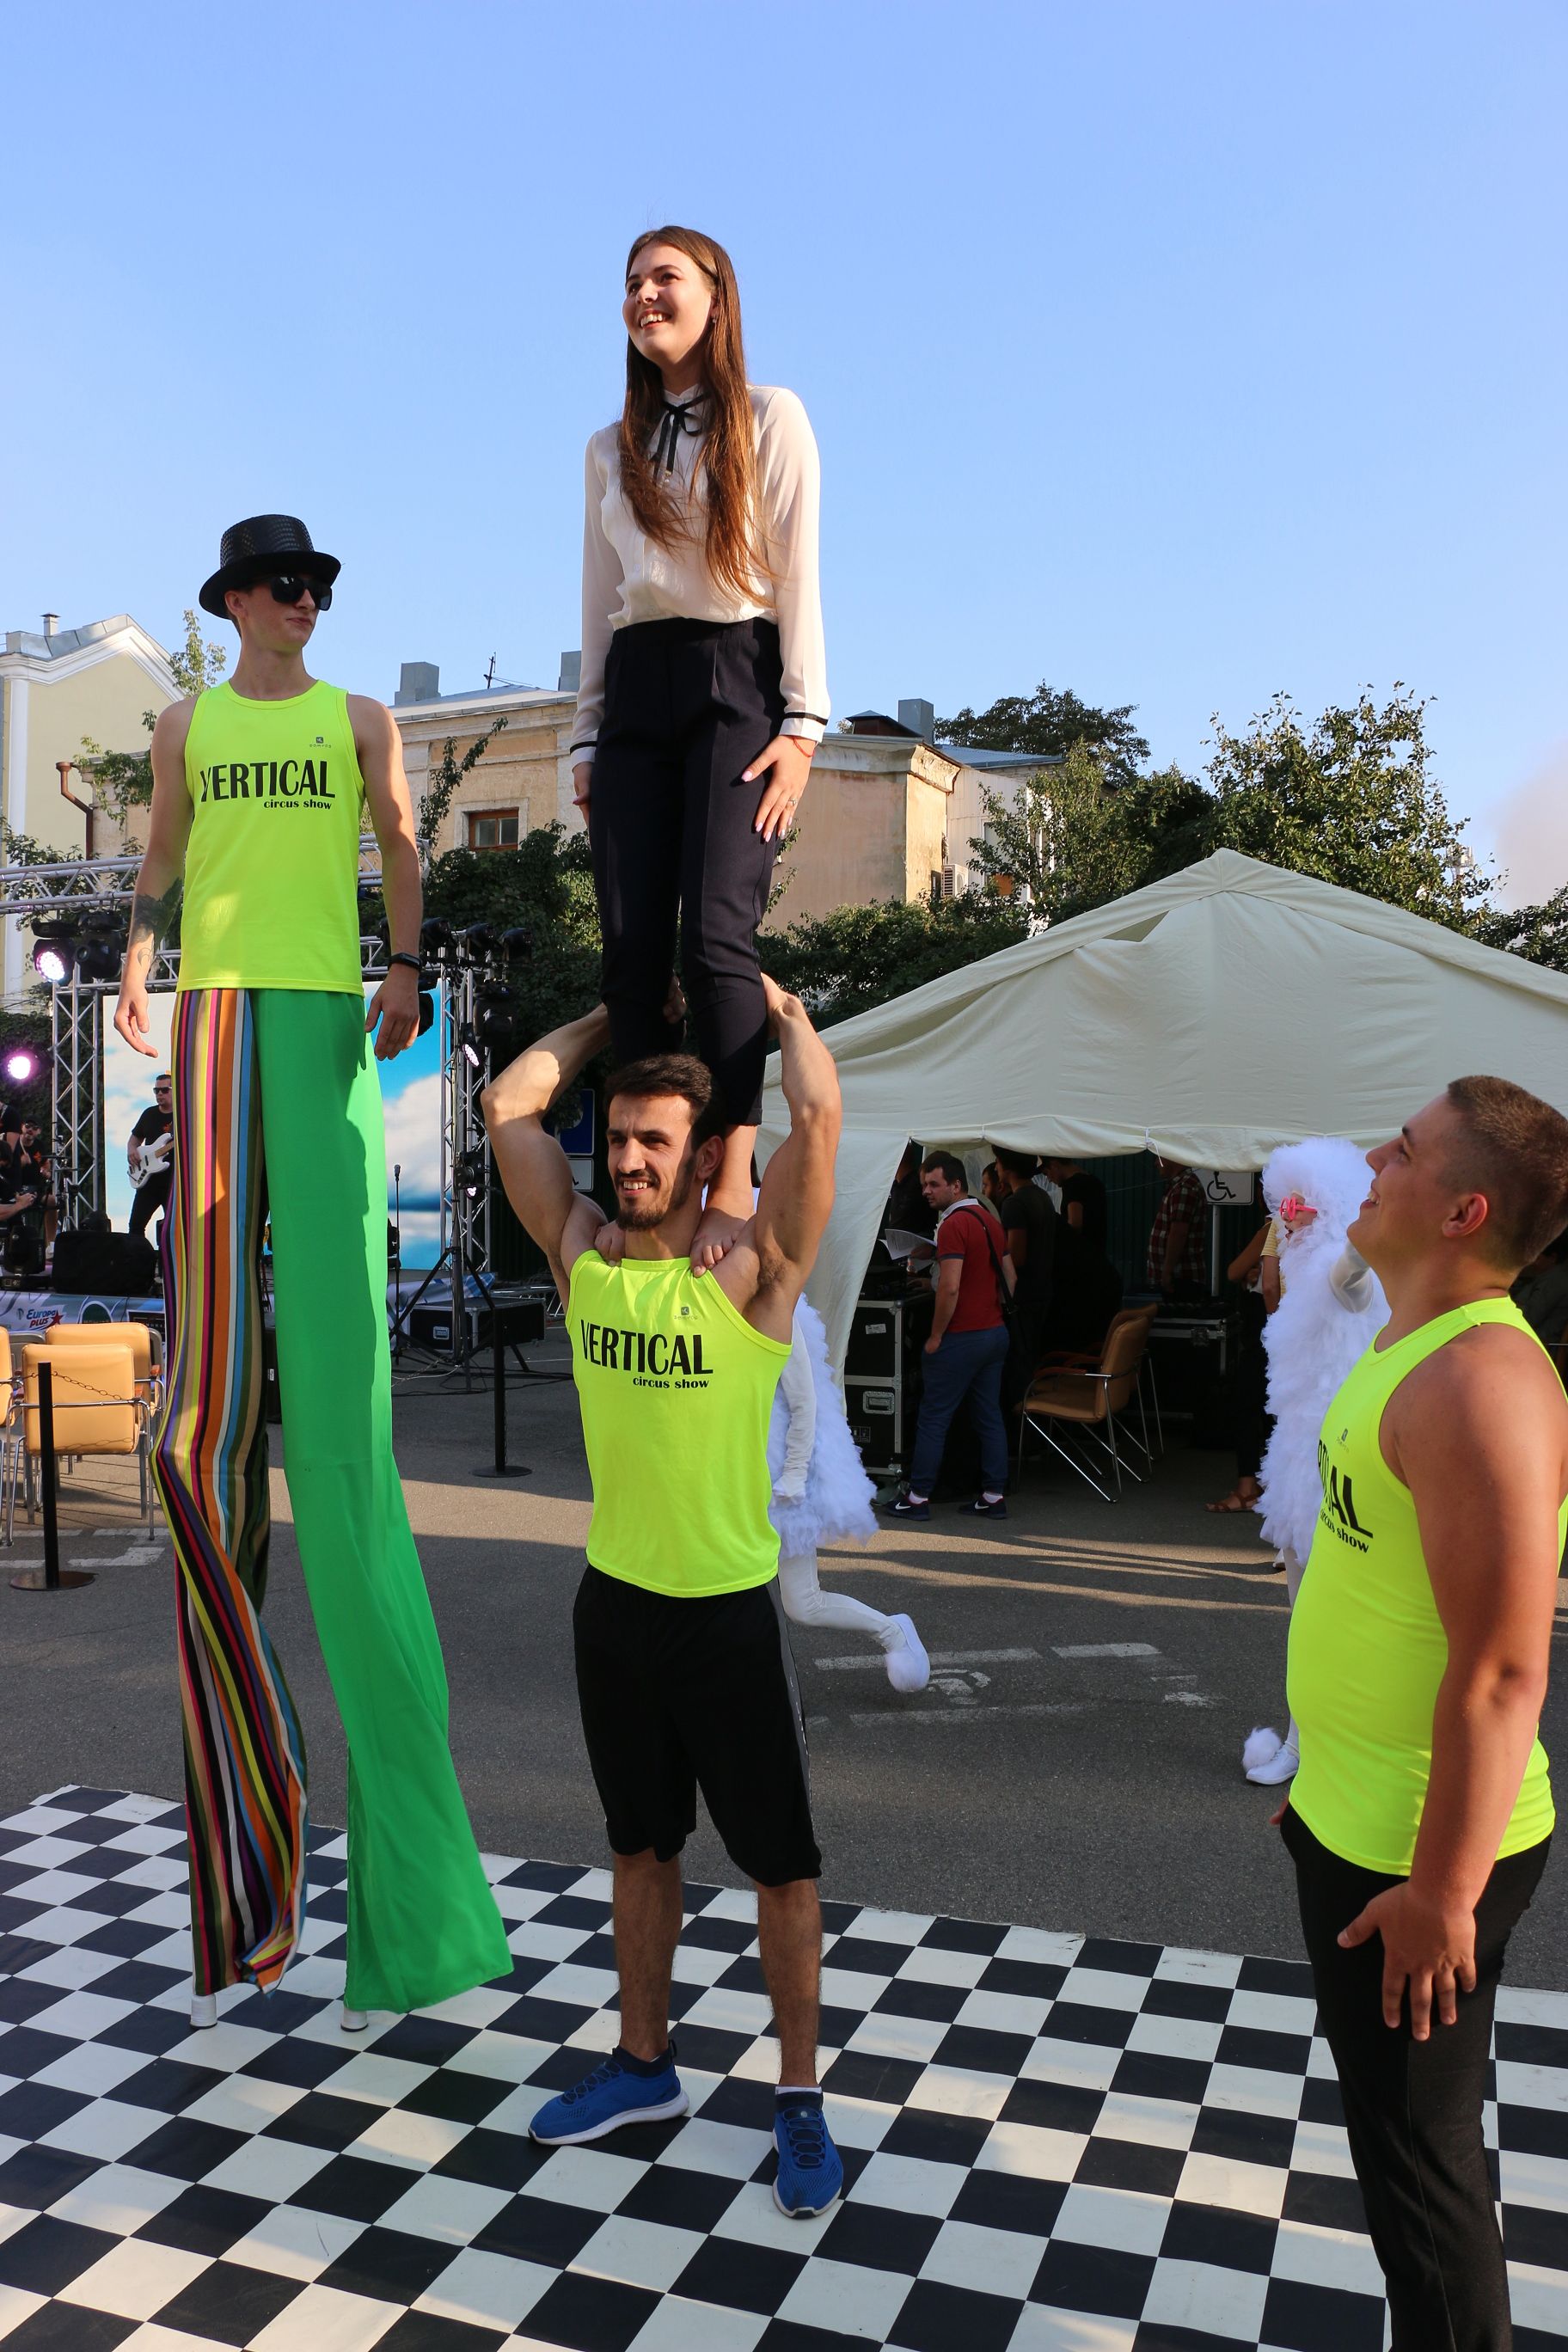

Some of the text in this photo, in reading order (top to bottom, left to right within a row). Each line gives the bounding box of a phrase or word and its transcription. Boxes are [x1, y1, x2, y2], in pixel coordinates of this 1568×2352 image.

[199, 759, 336, 803] VERTICAL
[263, 799, 332, 810] circus show
[580, 1319, 714, 1375] VERTICAL
[633, 1375, 710, 1389] circus show
[1336, 1527, 1369, 1554] show
